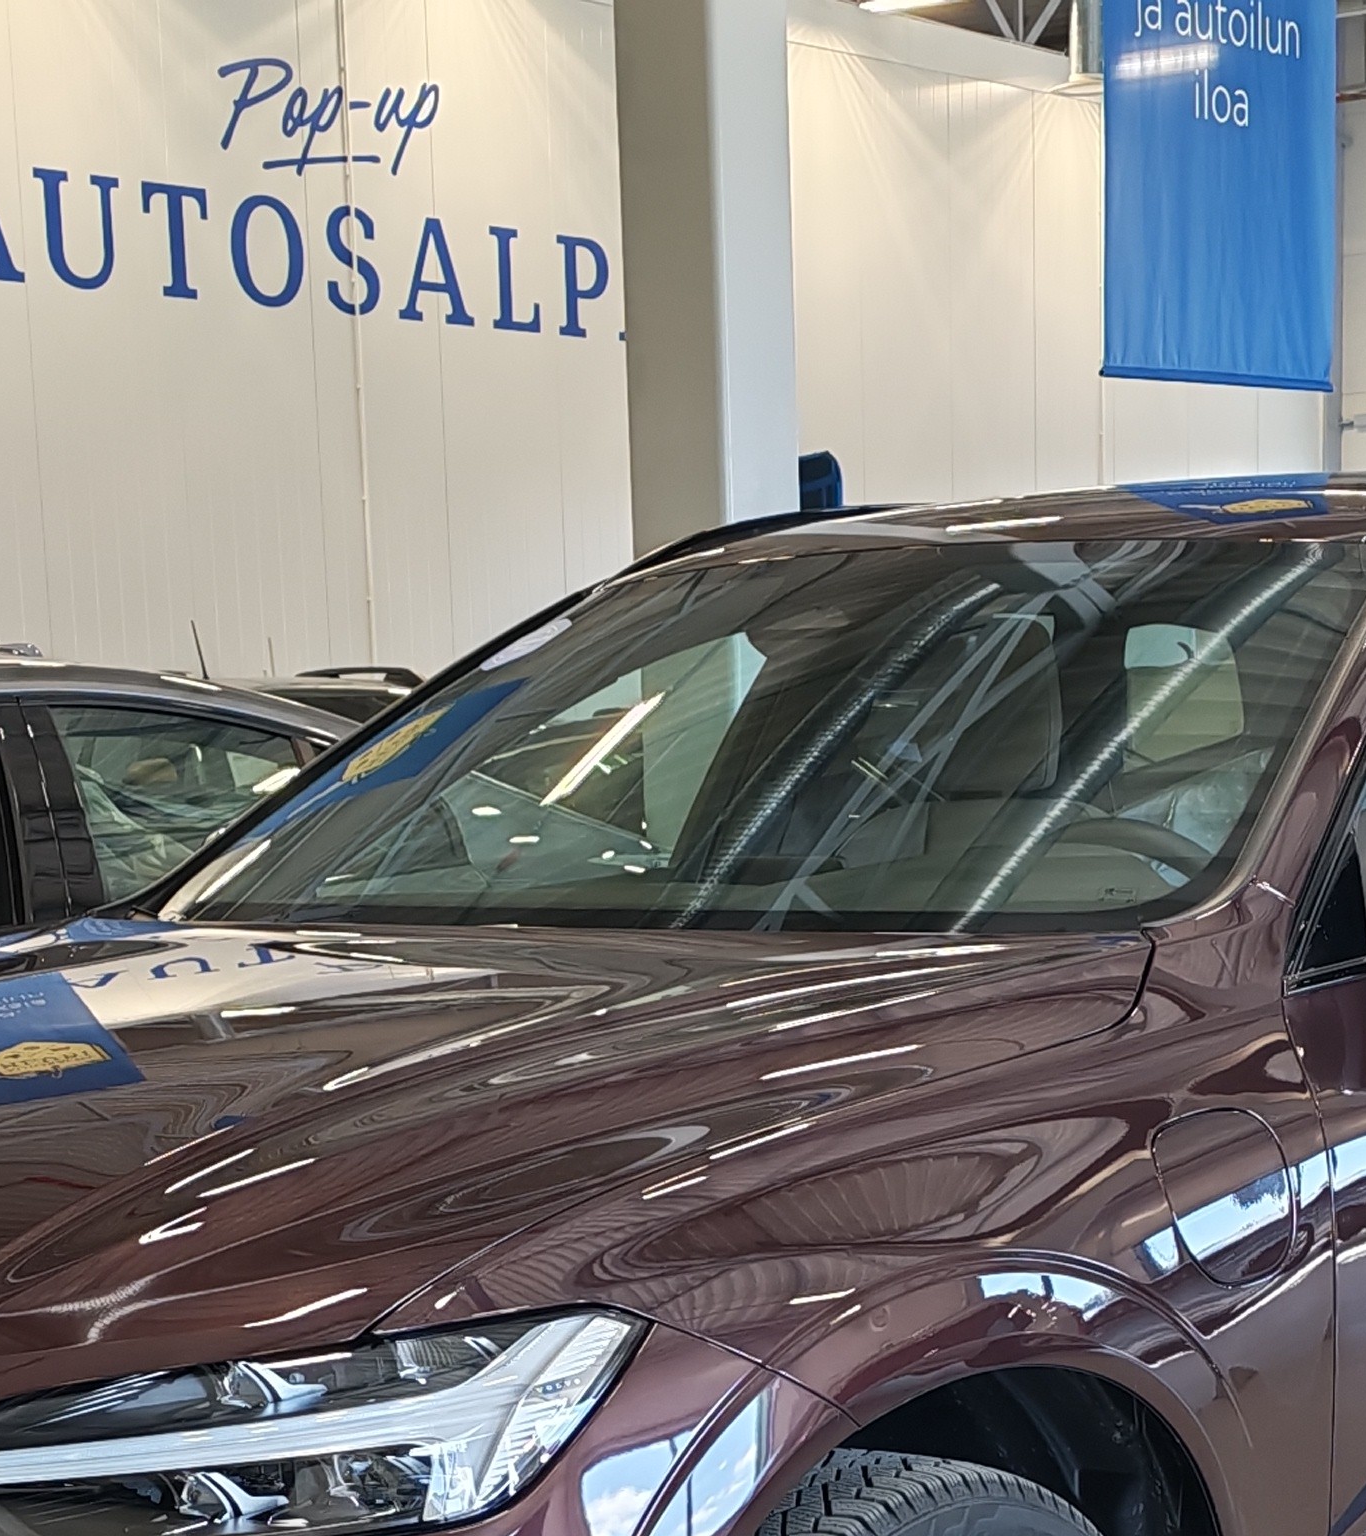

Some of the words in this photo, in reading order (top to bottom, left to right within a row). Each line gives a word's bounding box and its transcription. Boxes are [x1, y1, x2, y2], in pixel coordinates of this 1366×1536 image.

[1175, 0, 1301, 59] autoilun
[217, 57, 440, 176] Pop-up
[1195, 68, 1249, 127] iloa
[536, 1378, 581, 1393] VOLVO
